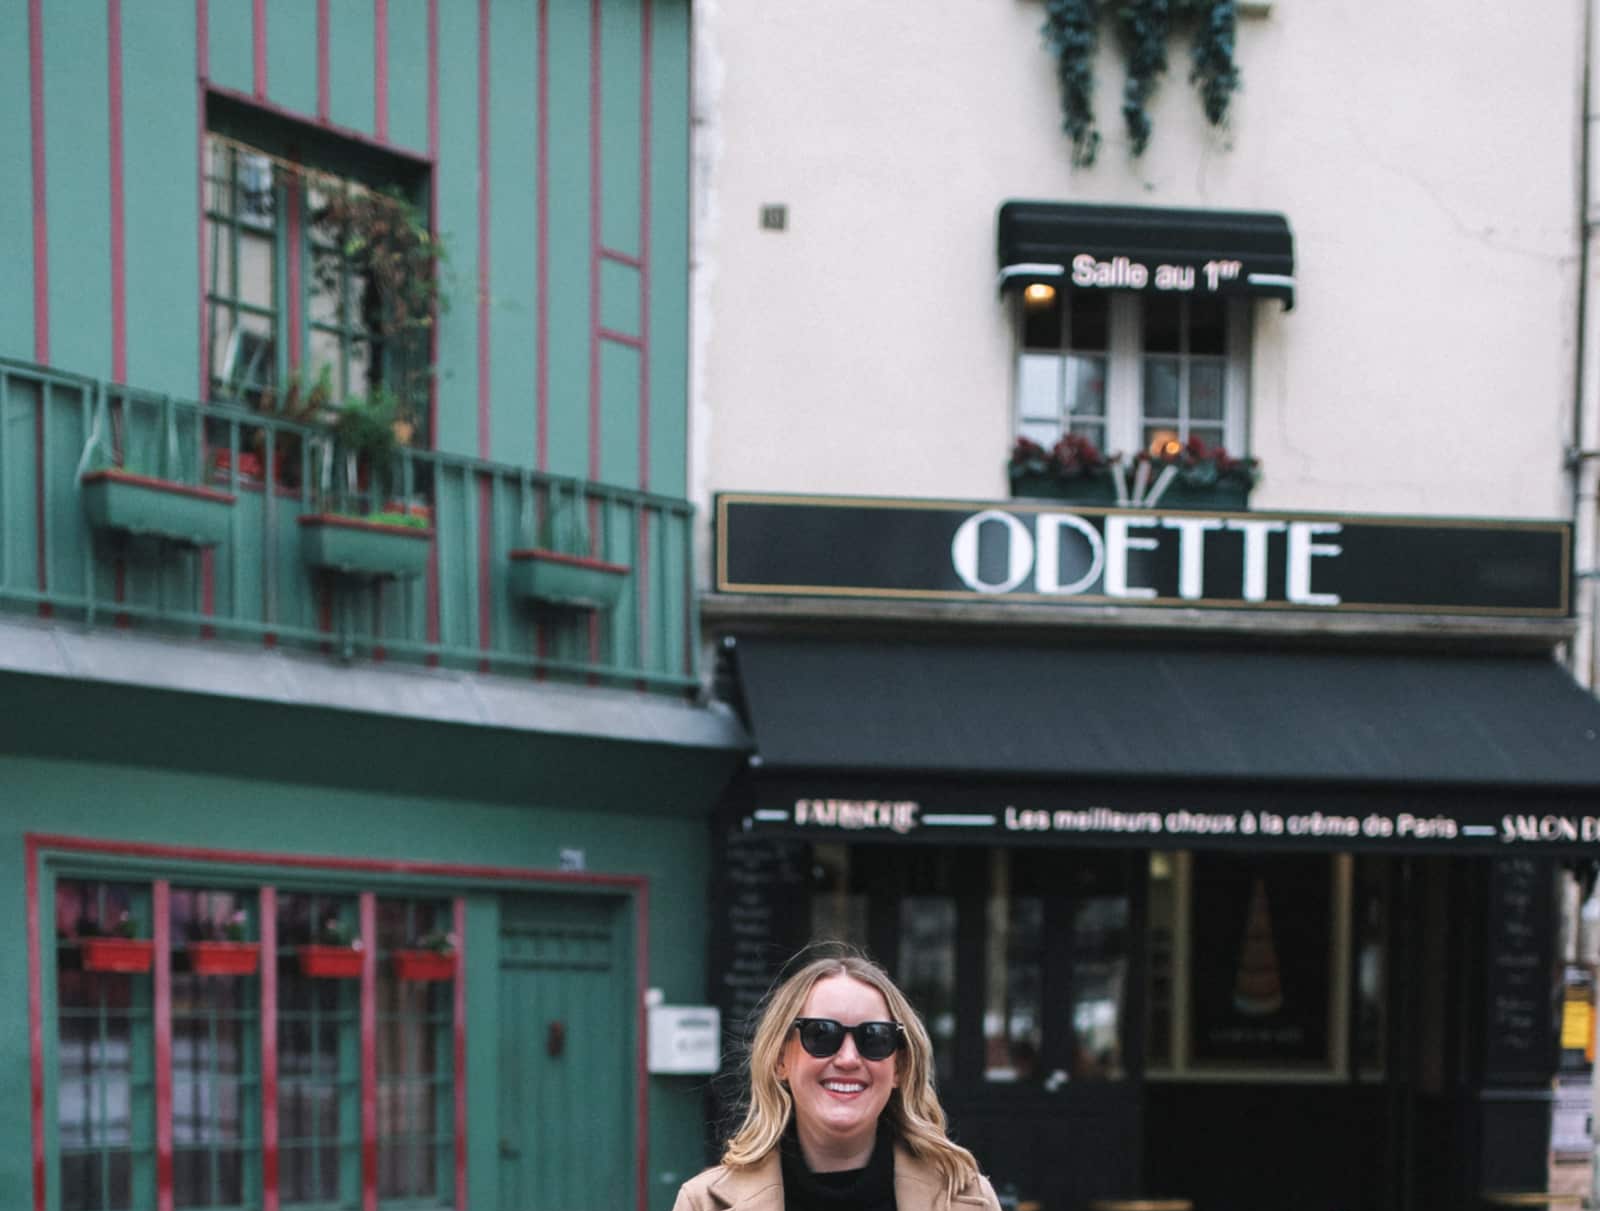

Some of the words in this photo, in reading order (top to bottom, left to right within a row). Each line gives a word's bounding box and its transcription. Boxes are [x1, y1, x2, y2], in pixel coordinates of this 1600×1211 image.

[1071, 254, 1149, 289] Salle
[1154, 264, 1196, 290] au
[951, 510, 1343, 606] ODETTE
[1005, 807, 1050, 831] Les
[1053, 808, 1162, 833] meilleurs
[1165, 811, 1237, 834] choux
[1259, 811, 1284, 835] la
[1362, 813, 1394, 837] de
[1397, 813, 1458, 839] Paris
[1502, 815, 1578, 843] SALON
